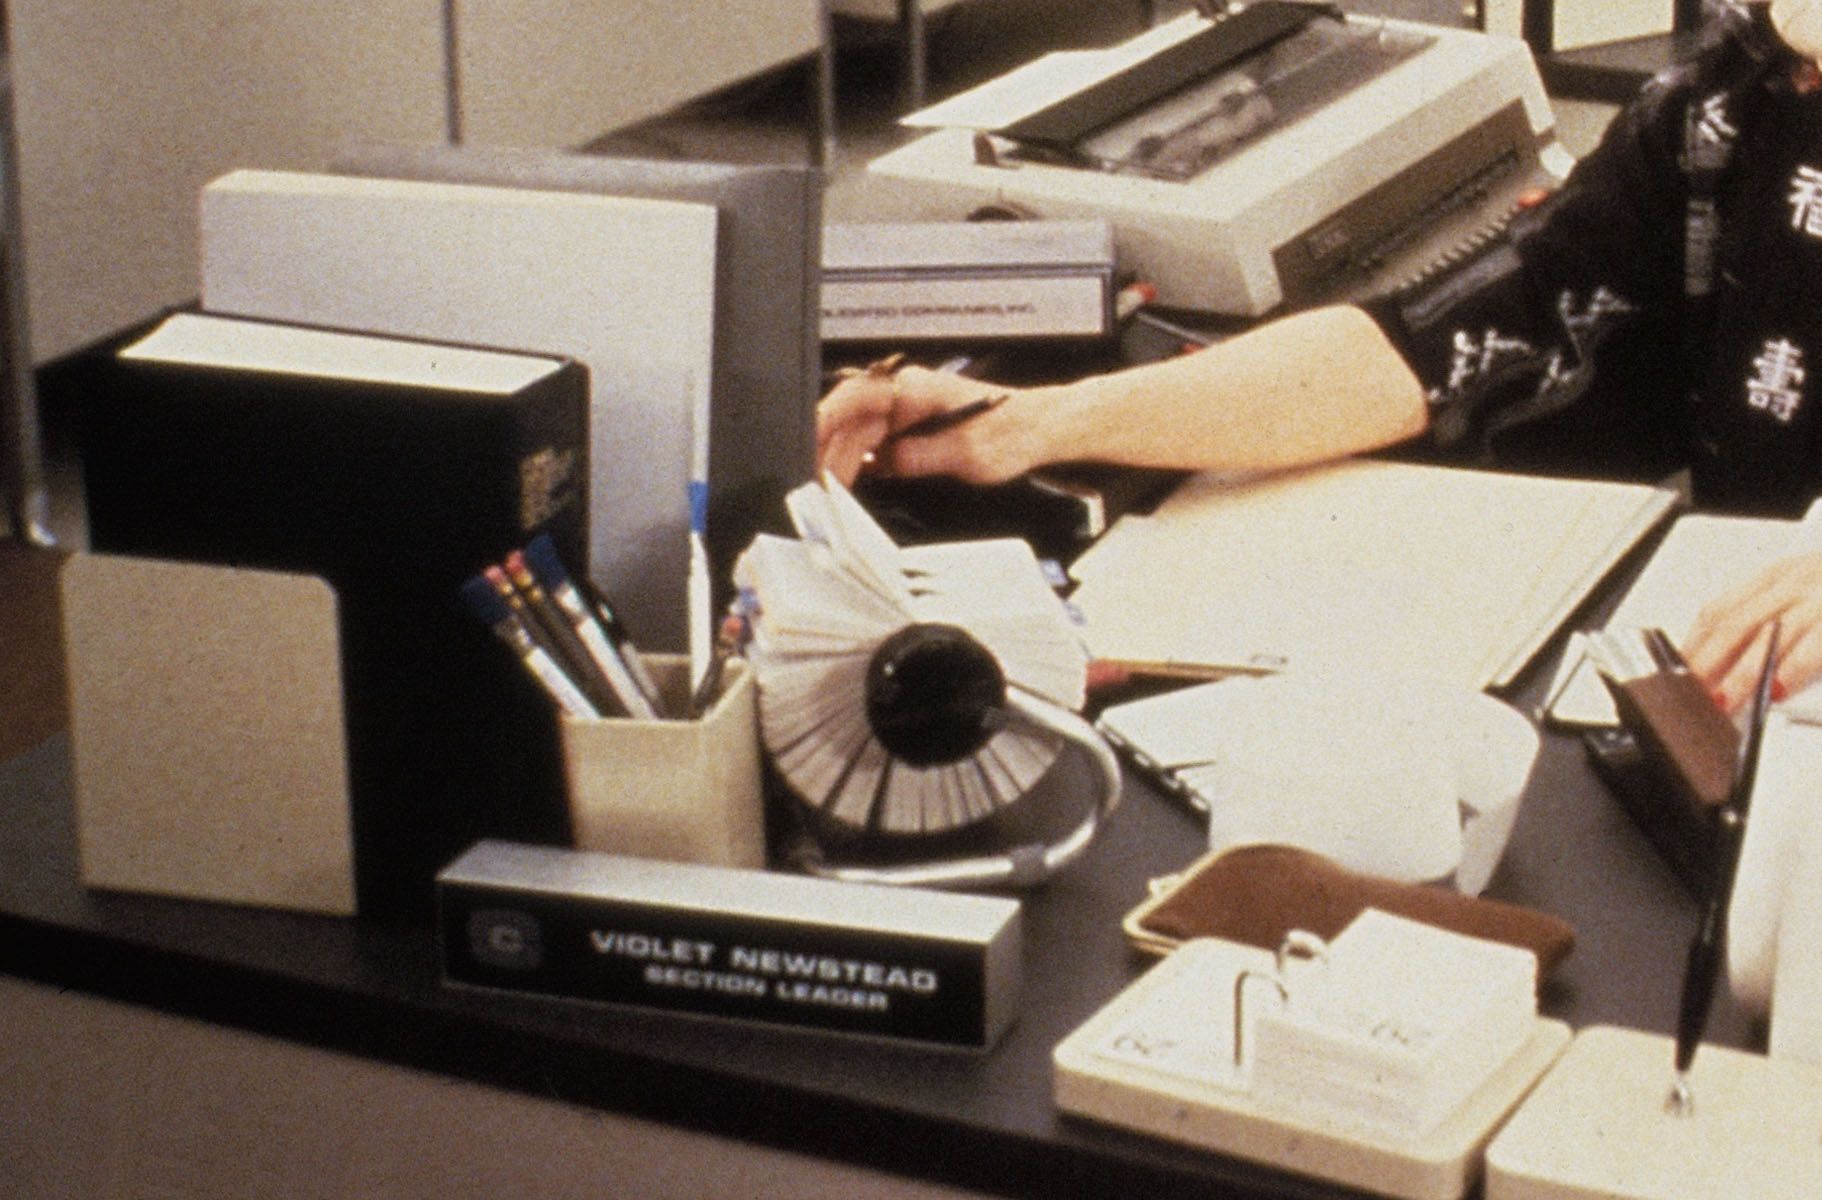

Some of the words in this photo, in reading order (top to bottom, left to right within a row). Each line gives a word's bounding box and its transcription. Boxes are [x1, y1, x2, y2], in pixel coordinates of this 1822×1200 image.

[590, 929, 715, 964] VIOLET
[731, 946, 938, 993] NEWSTEAD
[645, 964, 768, 996] SECTION
[775, 981, 888, 1010] LEADER
